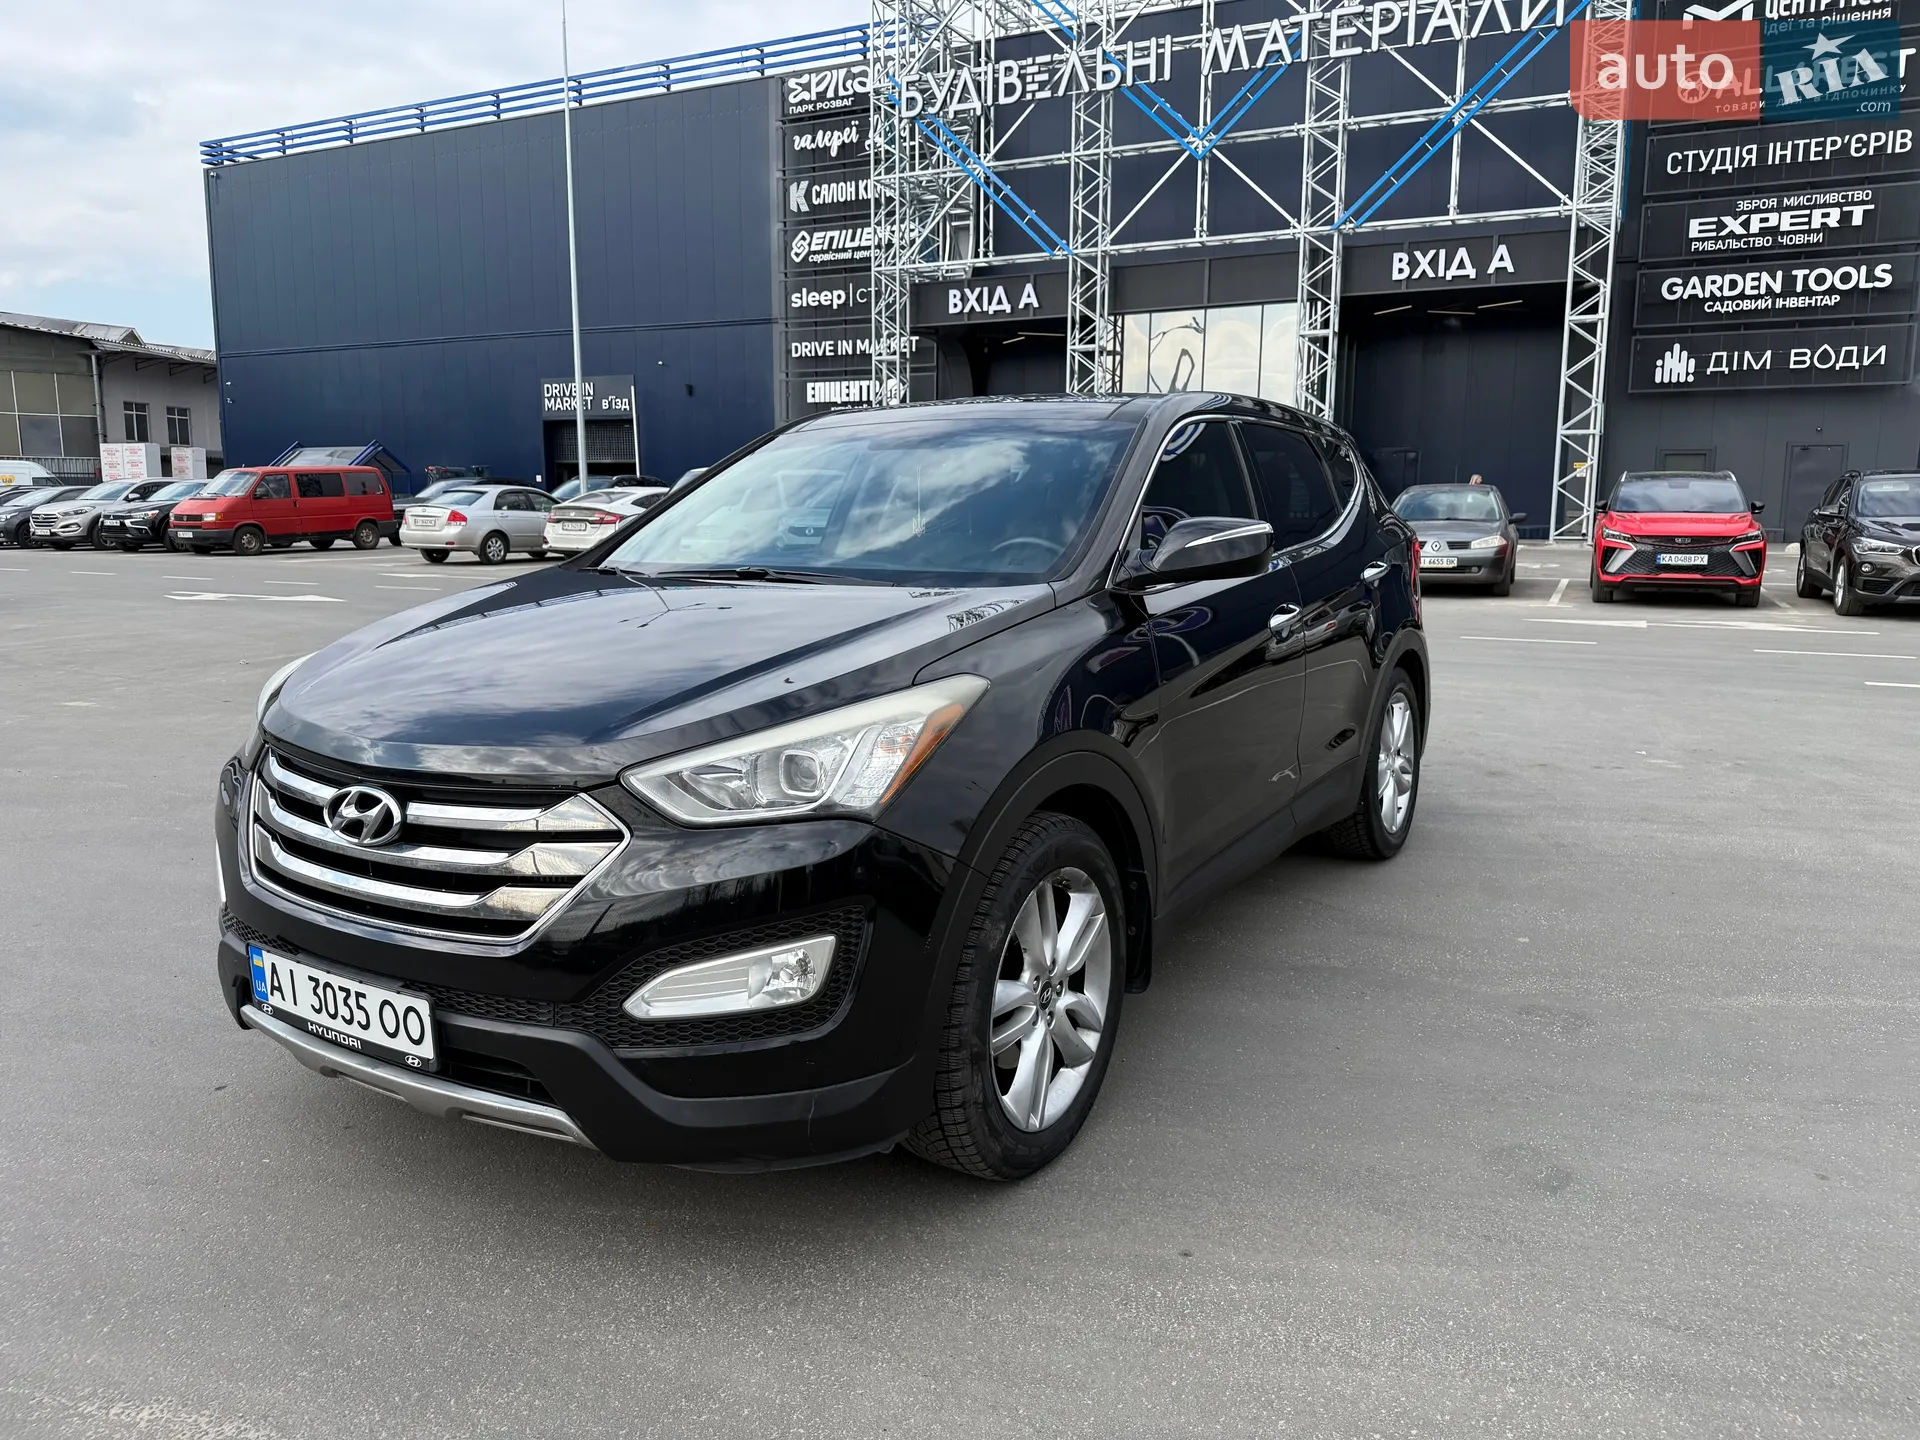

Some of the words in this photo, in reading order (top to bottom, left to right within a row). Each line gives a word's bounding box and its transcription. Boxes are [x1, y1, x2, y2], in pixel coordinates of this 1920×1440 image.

[1821, 7, 1892, 29] рішення
[901, 34, 1171, 118] БУДІВЕЛЬНІ
[1201, 0, 1565, 75] МАТЕРІАЛИ
[789, 102, 815, 114] ПАРК
[816, 97, 854, 111] РОЗВАГ
[1666, 144, 1758, 175] СТУДІЯ
[811, 180, 856, 205] САЛОН
[1735, 198, 1778, 212] ЗБРОЯ
[1783, 189, 1873, 208] МИСЛИВСТВО
[1688, 204, 1876, 239] EXPERT
[1691, 235, 1773, 252] РИБАЛЬСТВО
[1778, 232, 1824, 246] ЧОВНИ
[808, 249, 852, 264] сервісний
[1391, 246, 1477, 281] ВХІД
[1486, 244, 1515, 275] А
[1660, 270, 1783, 301] GARDEN
[1791, 263, 1893, 293] TOOLS
[790, 287, 846, 310] sleep
[948, 285, 1012, 315] ВХІД
[1018, 283, 1040, 309] А
[1704, 296, 1772, 313] САДОВИЙ
[1775, 294, 1841, 309] ІНВЕНТАР
[791, 340, 835, 357] DRIVE
[837, 339, 853, 356] IN
[1706, 349, 1772, 375] ДІМ
[1789, 344, 1887, 371] ВОДИ
[543, 382, 578, 397] DRIVE
[582, 381, 594, 396] IN
[255, 979, 268, 994] UA
[269, 961, 298, 1007] AI
[307, 974, 371, 1031] 3035
[378, 999, 425, 1046] OO
[307, 1021, 362, 1050] HYUNDAI
